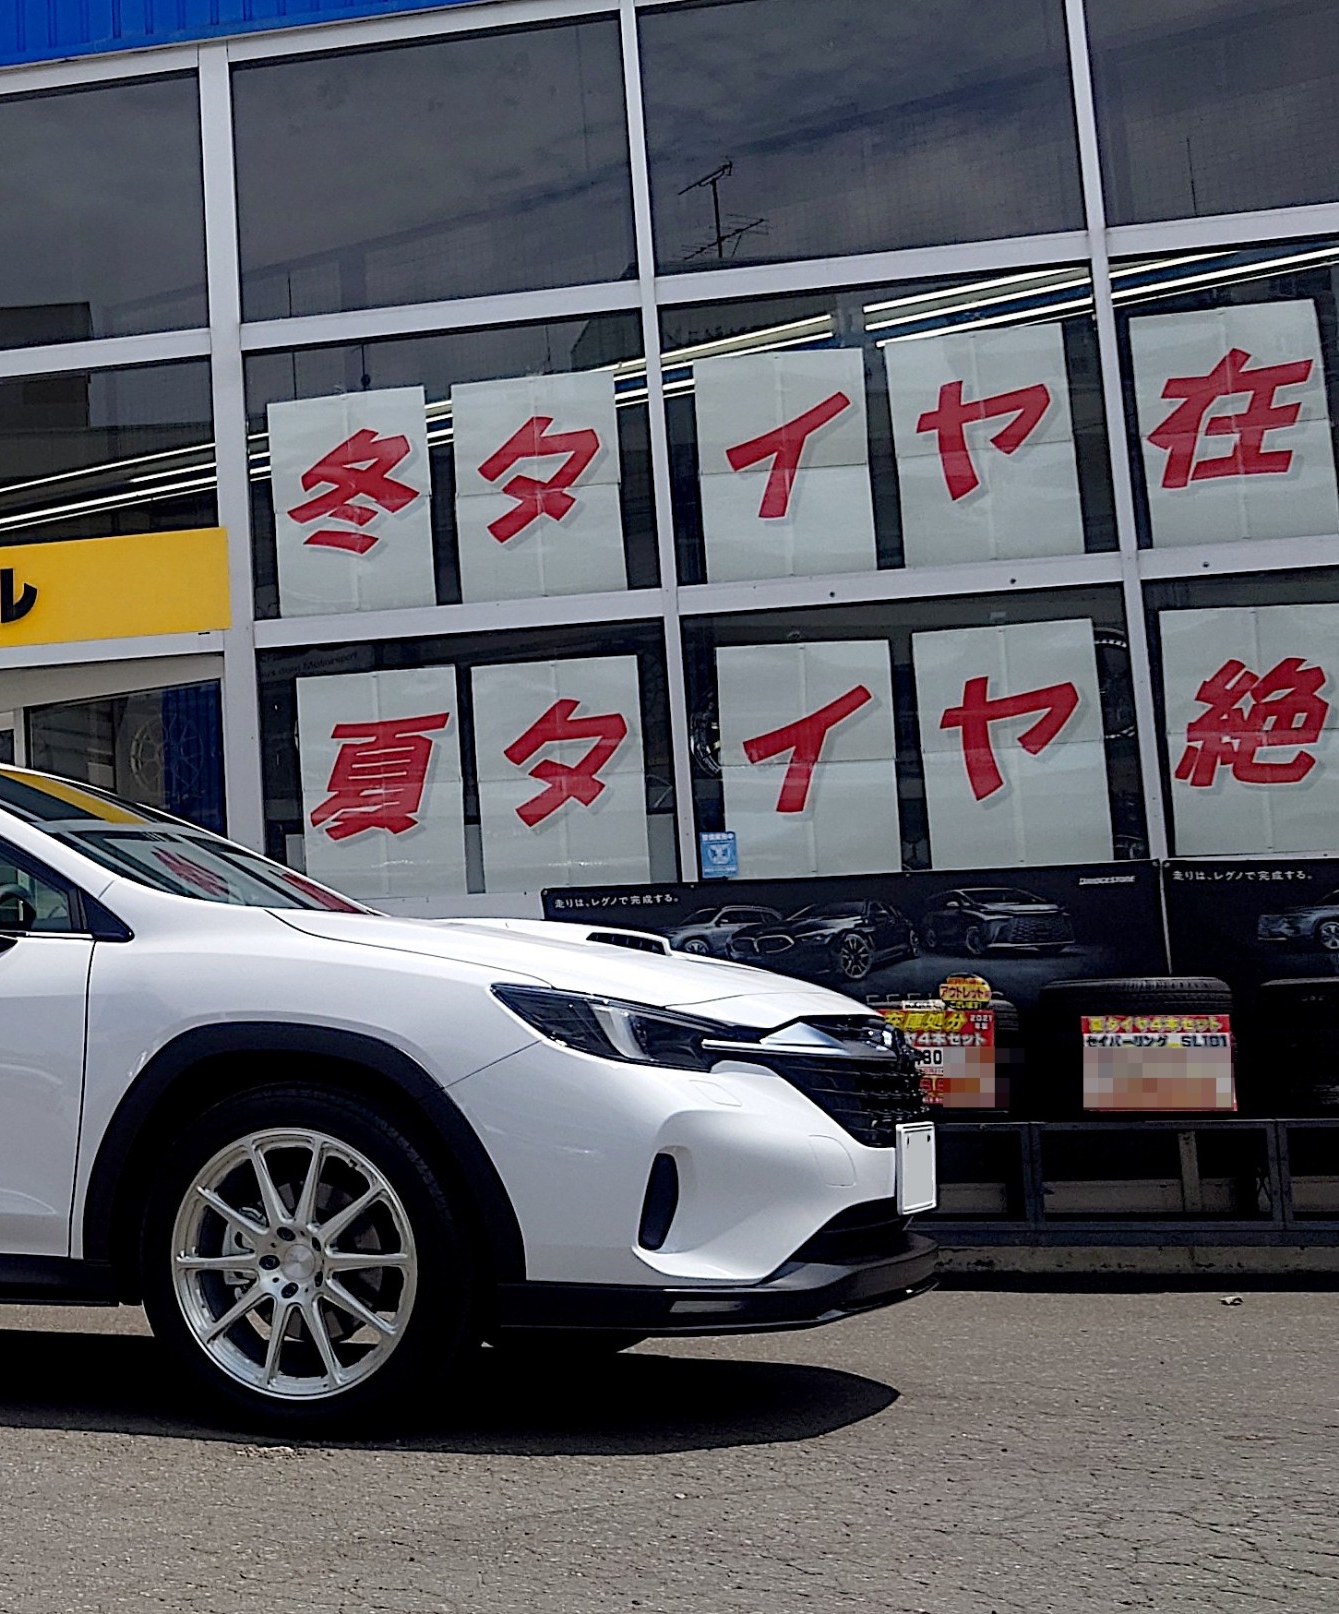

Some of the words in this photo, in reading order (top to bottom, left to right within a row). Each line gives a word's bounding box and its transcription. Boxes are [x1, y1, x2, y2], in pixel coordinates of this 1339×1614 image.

[1172, 870, 1313, 881] 走りは、レグノで完成する。
[555, 894, 679, 909] 走りは、レグノで完成する。
[1086, 1035, 1169, 1047] セイバーリング
[1181, 1035, 1228, 1047] SL101
[918, 1049, 943, 1065] 80
